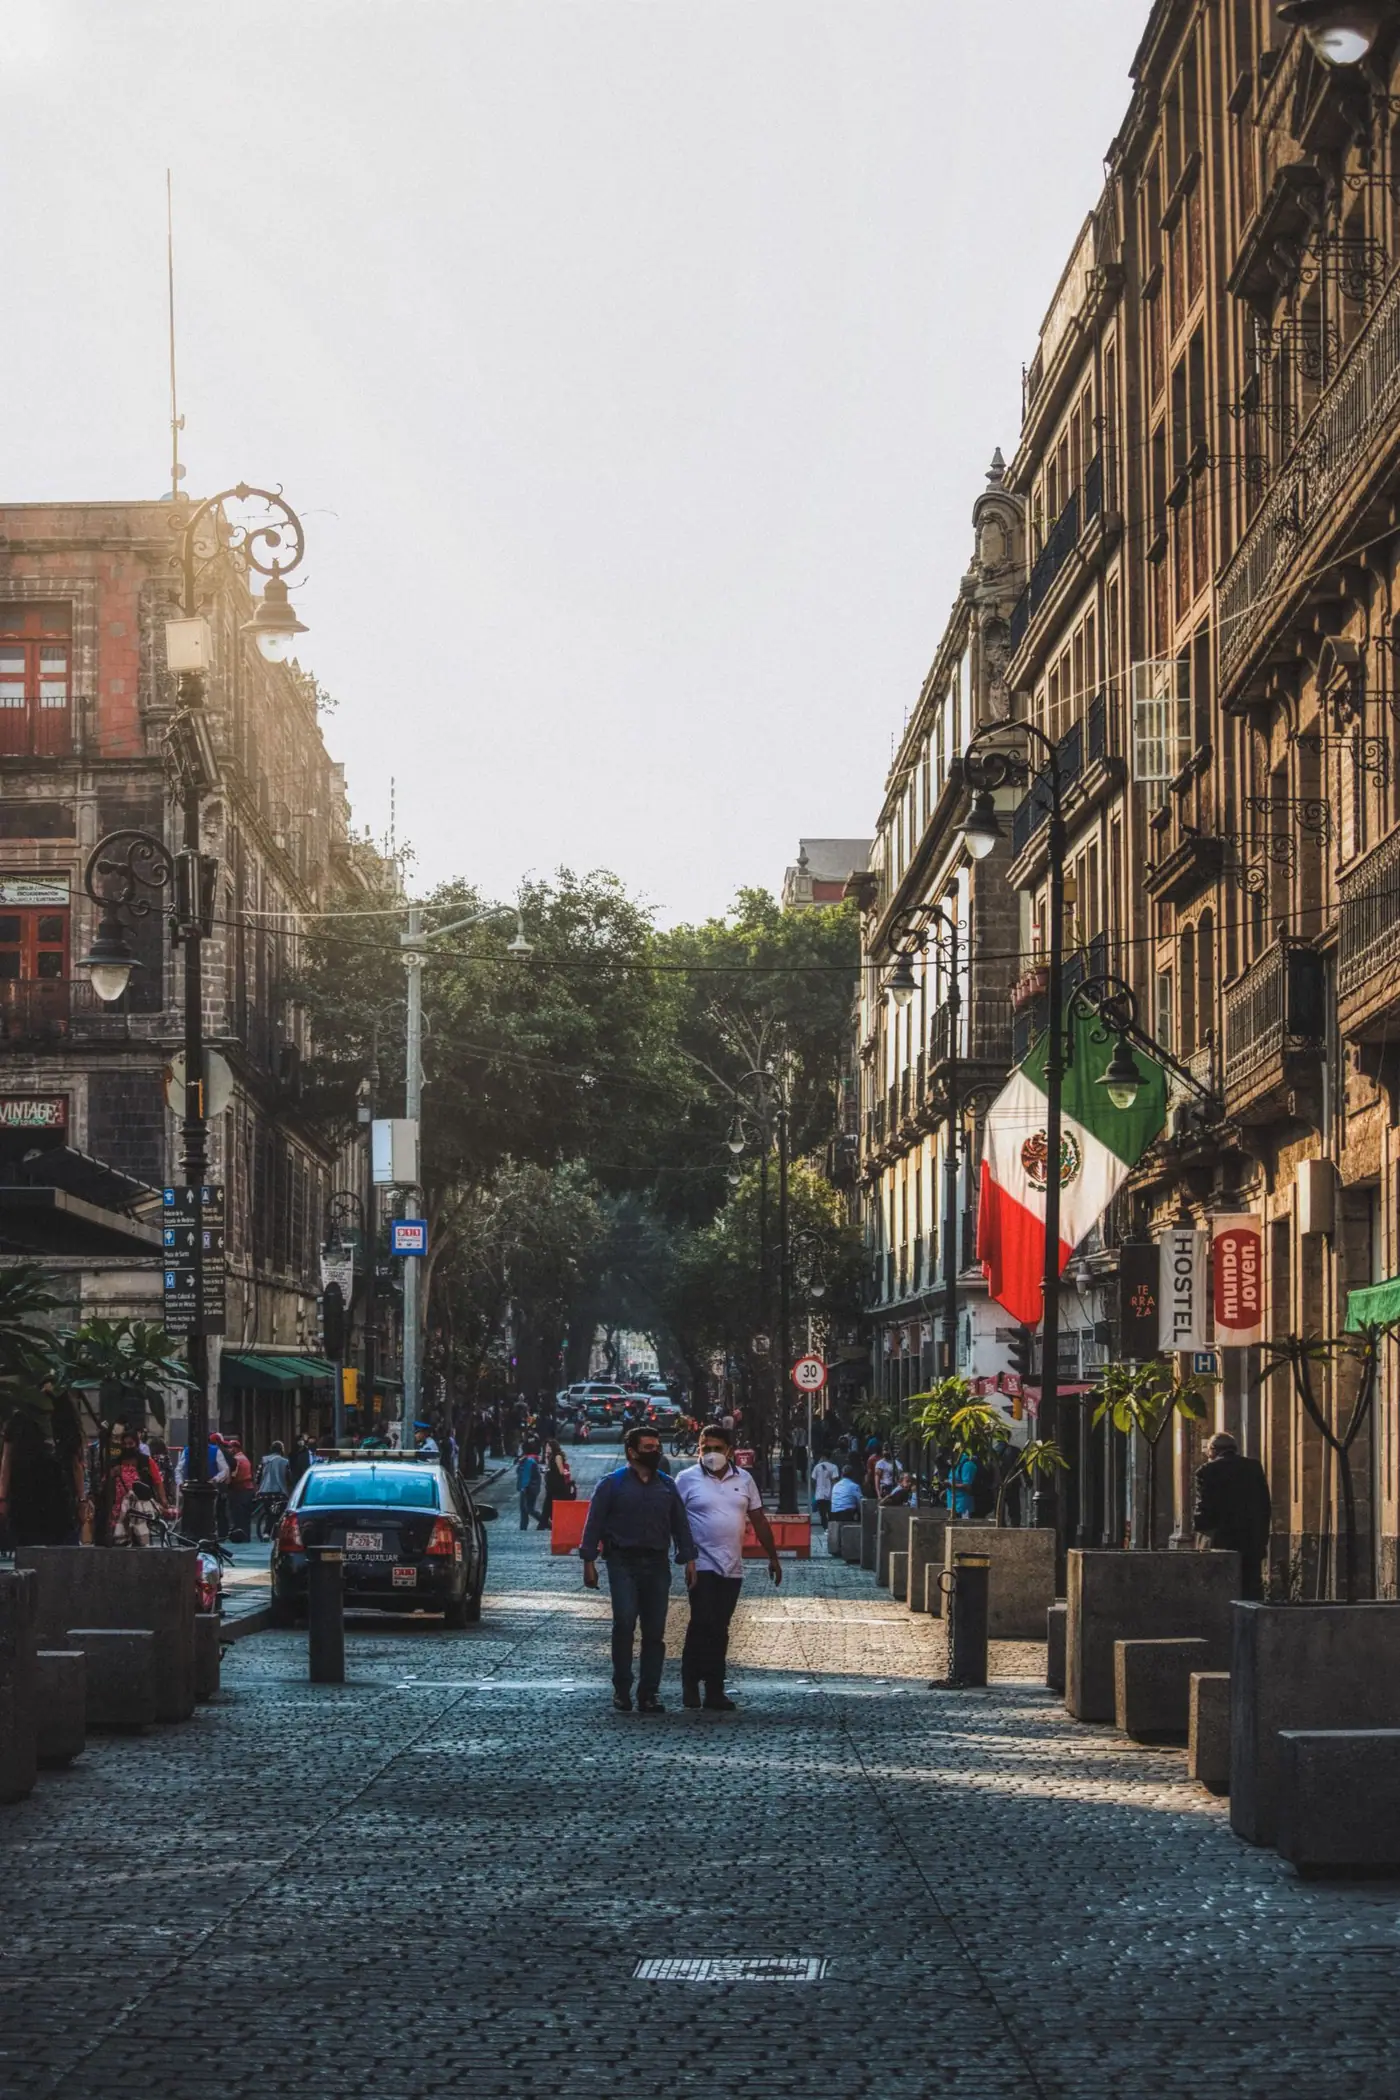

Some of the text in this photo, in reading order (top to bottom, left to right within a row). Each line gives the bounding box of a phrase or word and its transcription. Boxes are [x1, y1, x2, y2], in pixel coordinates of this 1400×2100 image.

[0, 1101, 56, 1124] VINTAGE
[1137, 1285, 1149, 1295] TE
[1173, 1238, 1193, 1343] HOSTEL
[1131, 1296, 1156, 1306] RRA
[1136, 1307, 1152, 1317] ZA
[803, 1364, 817, 1378] 30
[365, 1554, 399, 1562] AUXILIAR
